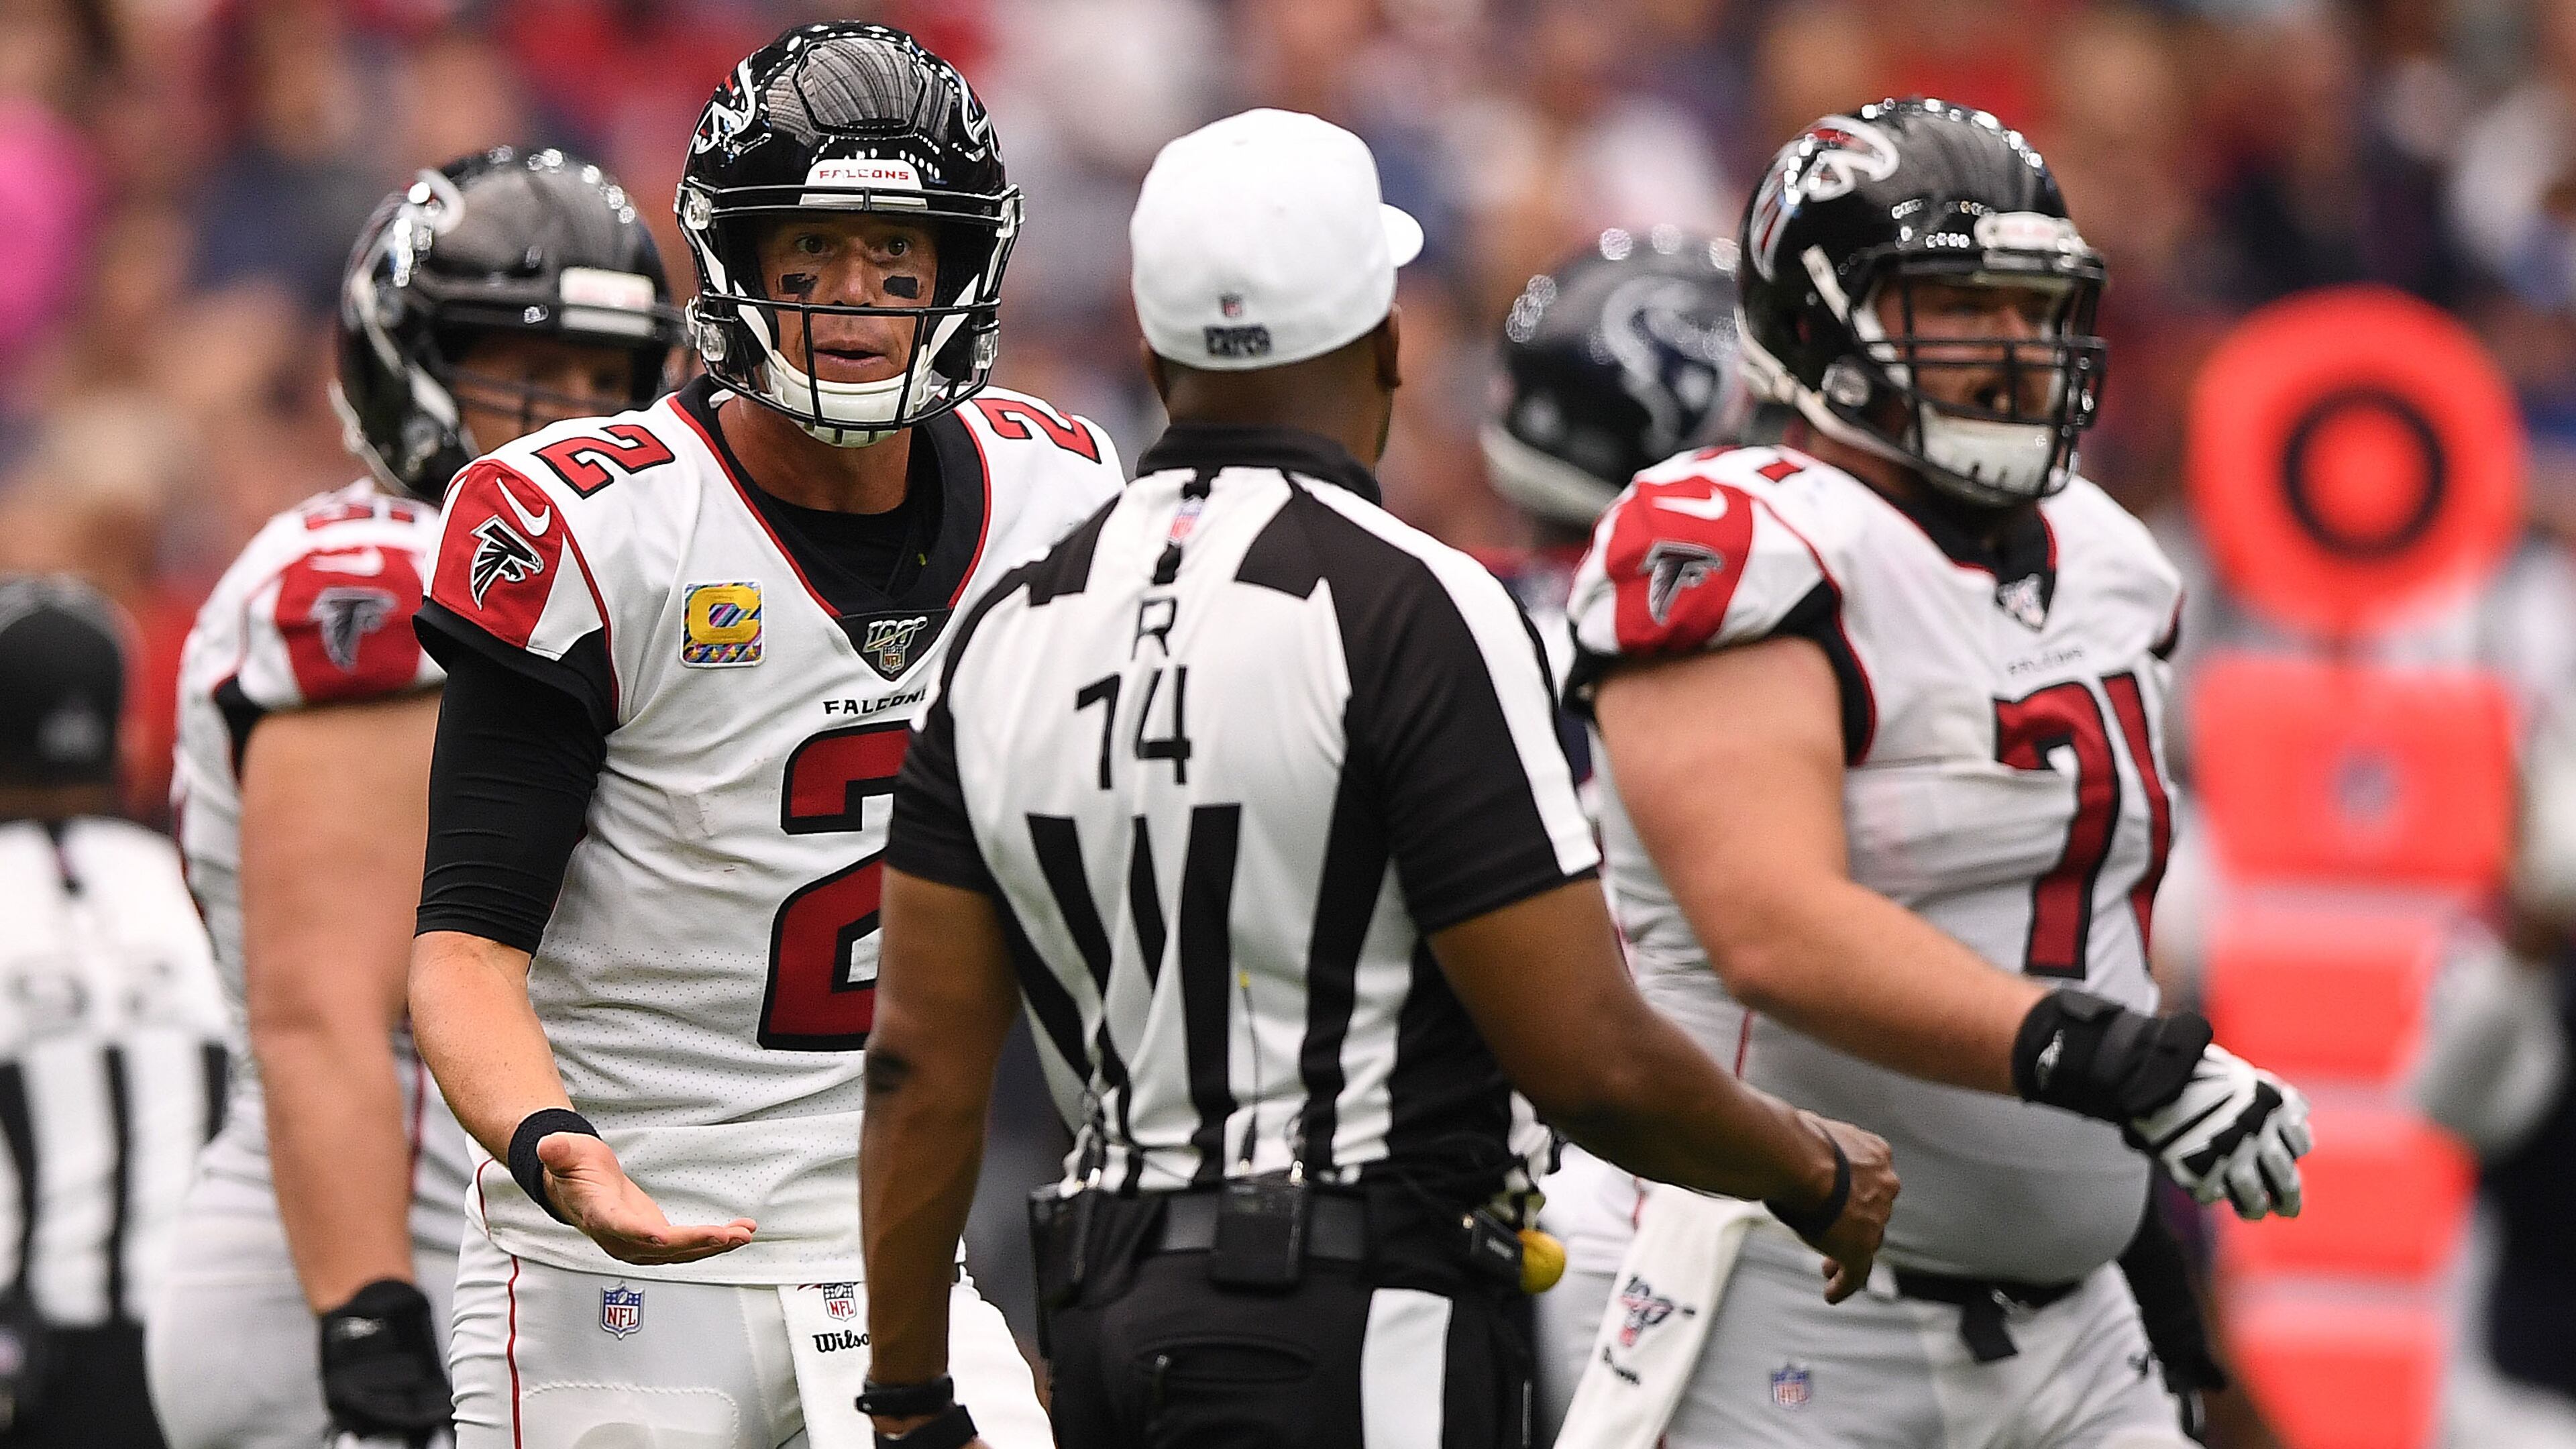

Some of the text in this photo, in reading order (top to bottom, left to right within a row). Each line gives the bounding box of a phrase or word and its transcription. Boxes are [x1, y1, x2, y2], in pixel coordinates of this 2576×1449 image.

[819, 169, 909, 180] FALCONS
[531, 423, 677, 500] 2
[972, 396, 1102, 465] 2
[688, 585, 761, 645] C
[1131, 596, 1177, 661] R
[1075, 665, 1191, 791] 14
[1990, 670, 2171, 980] 71
[756, 719, 914, 1051] 2
[606, 1307, 637, 1328] NFL
[812, 1329, 870, 1353] Wilso
[829, 1299, 854, 1318] NFL
